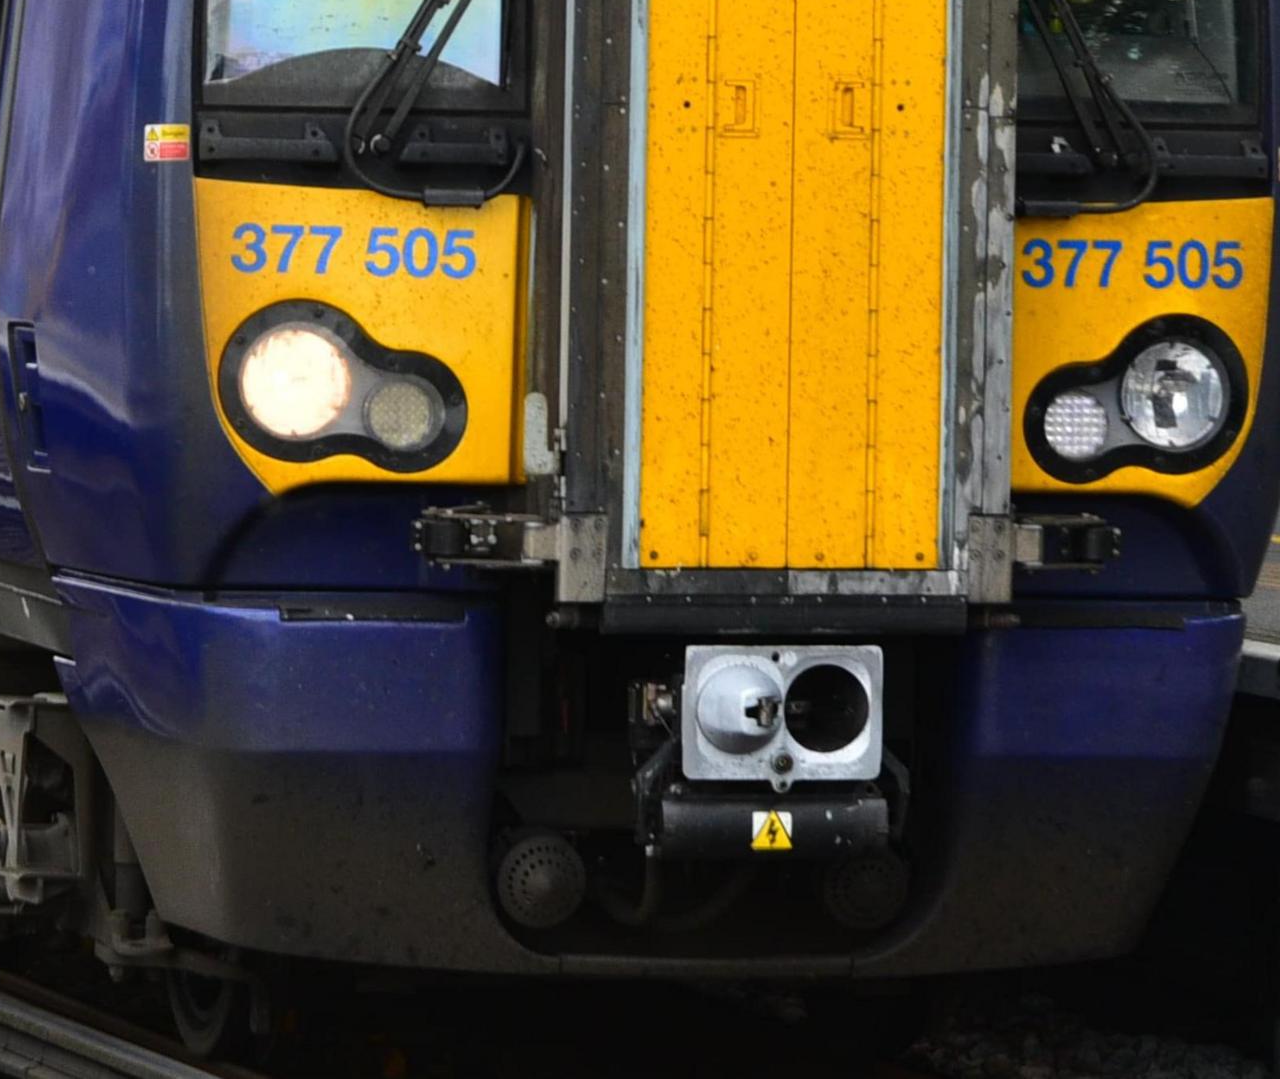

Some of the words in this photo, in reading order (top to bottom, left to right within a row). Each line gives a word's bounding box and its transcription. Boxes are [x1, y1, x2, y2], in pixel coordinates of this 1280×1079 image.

[231, 222, 343, 274] 377
[364, 226, 477, 279] 505
[1022, 238, 1123, 288] 377
[1143, 239, 1244, 289] 505
